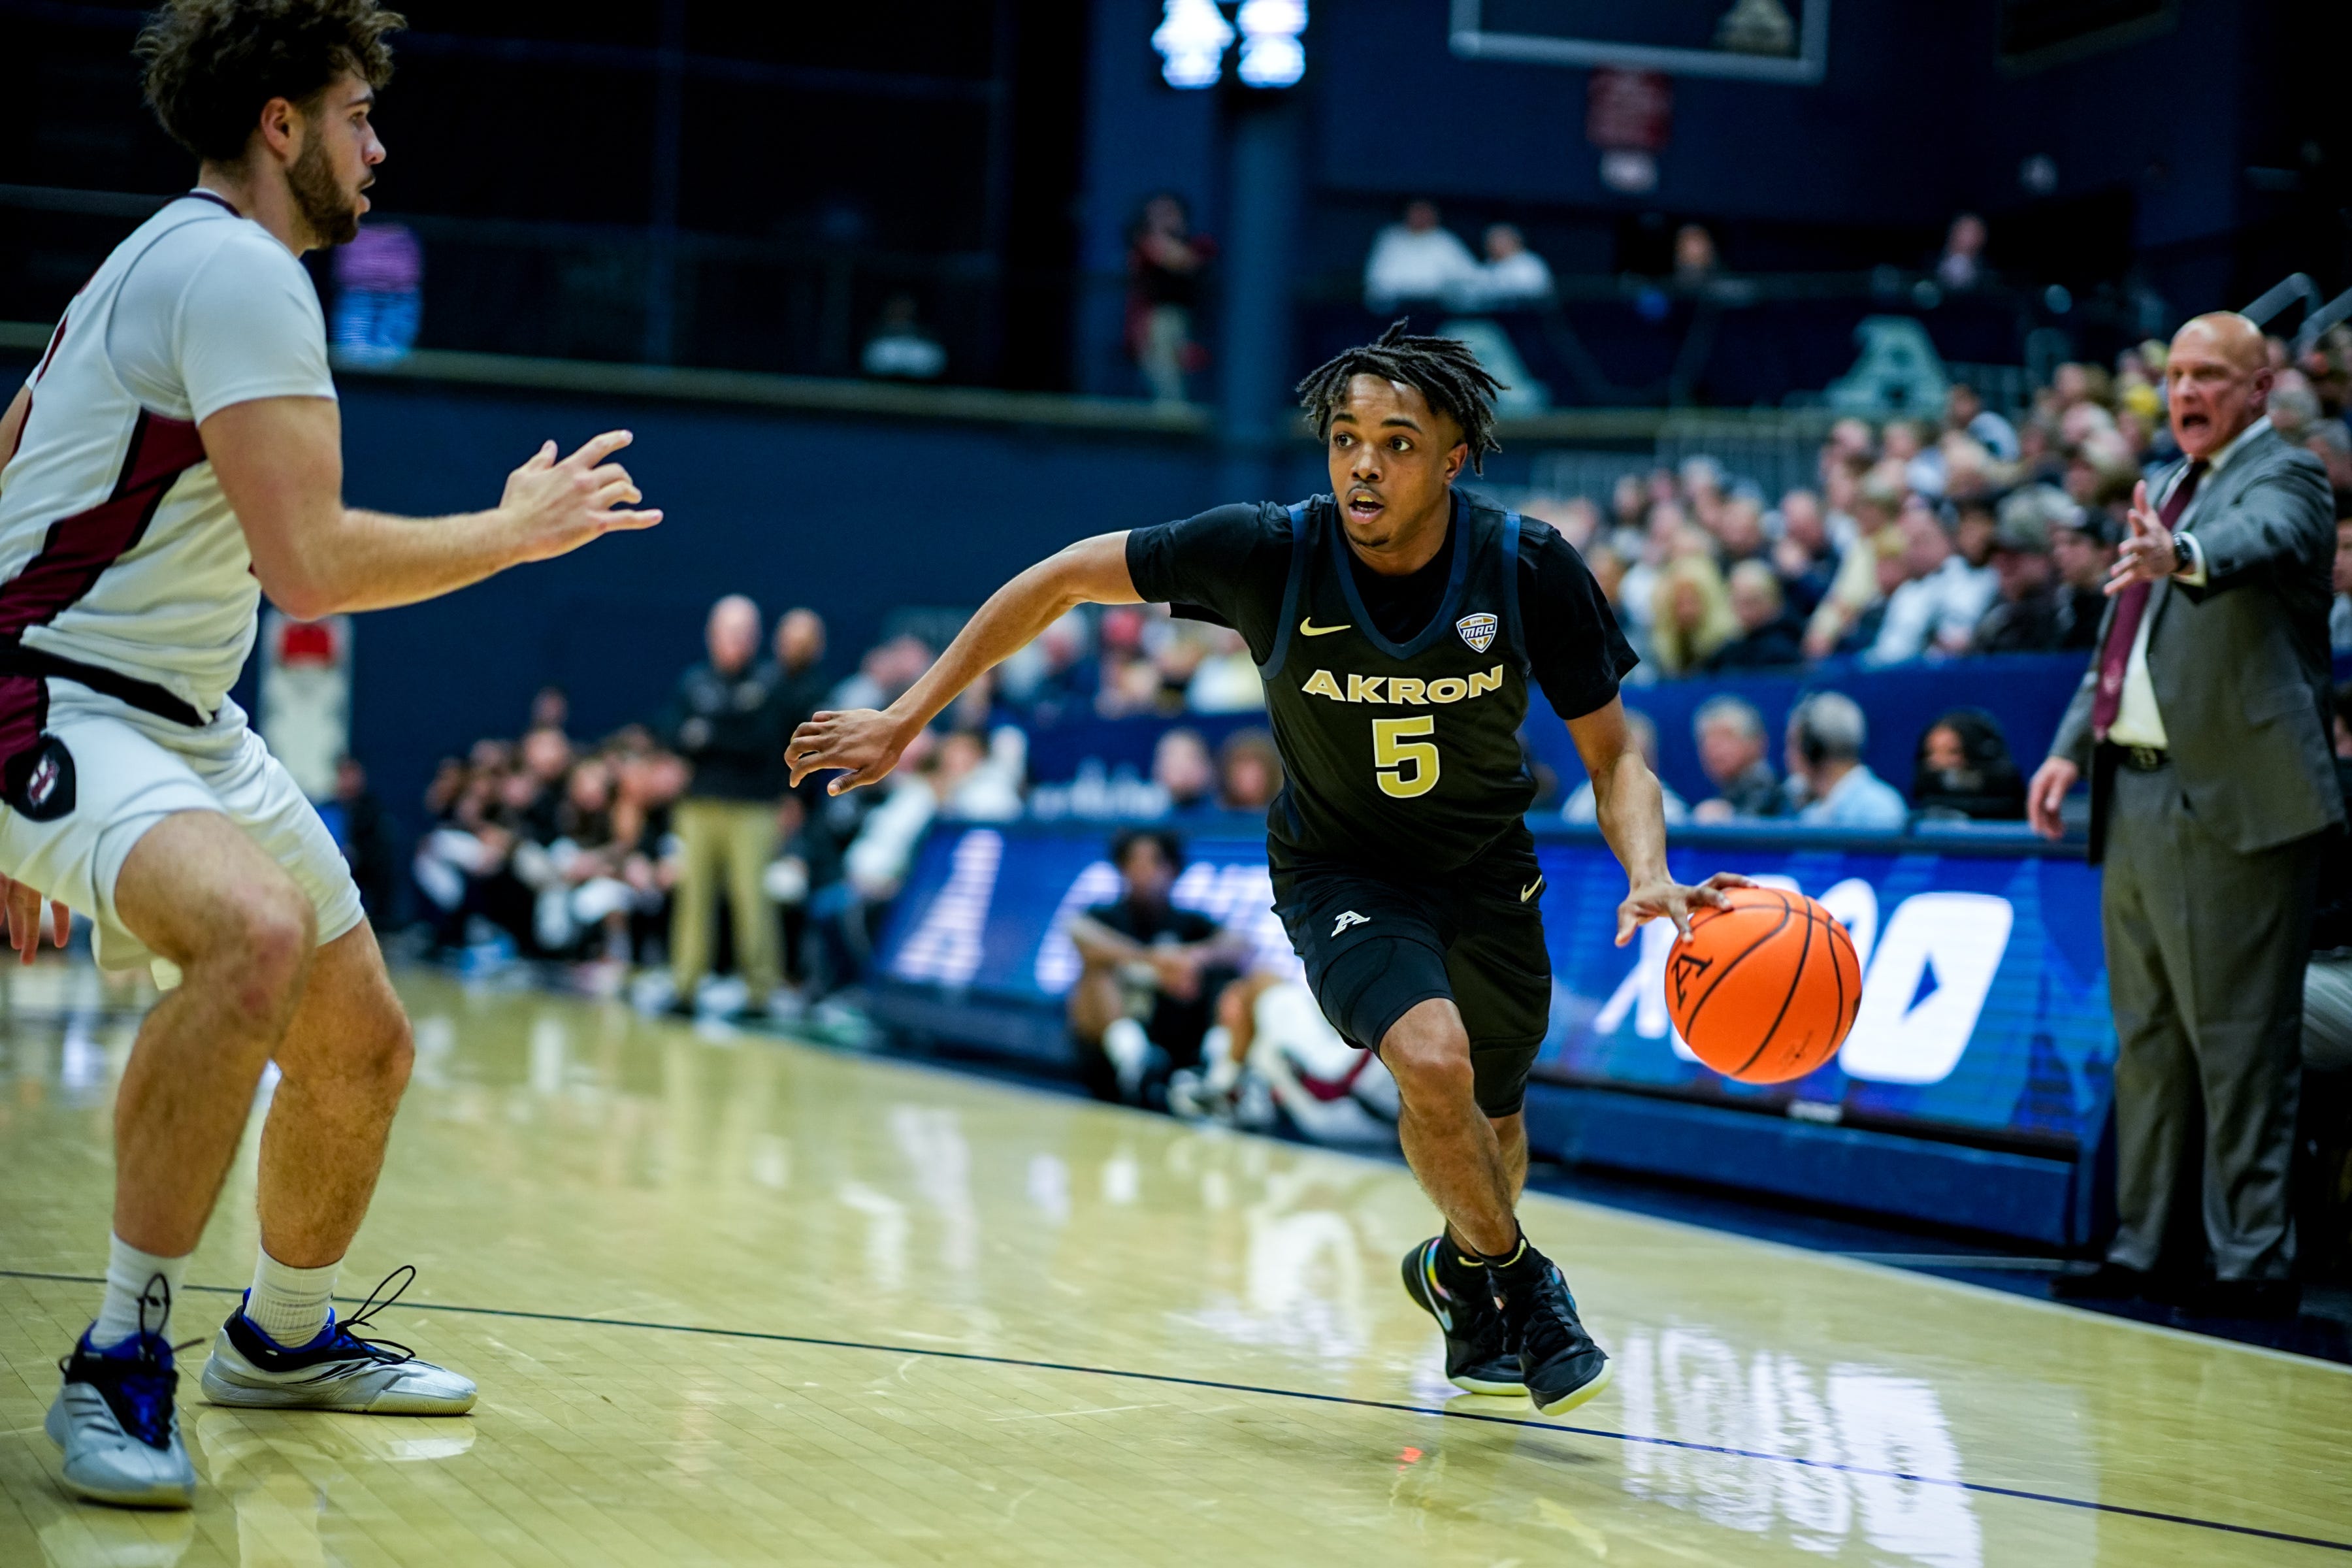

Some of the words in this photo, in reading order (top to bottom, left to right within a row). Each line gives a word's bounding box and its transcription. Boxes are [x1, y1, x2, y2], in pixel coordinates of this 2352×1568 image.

[1462, 625, 1495, 638] MAC
[1301, 664, 1503, 705] AKRON
[1372, 715, 1440, 798] 5
[1331, 910, 1371, 938] A
[1671, 954, 1714, 1011] A
